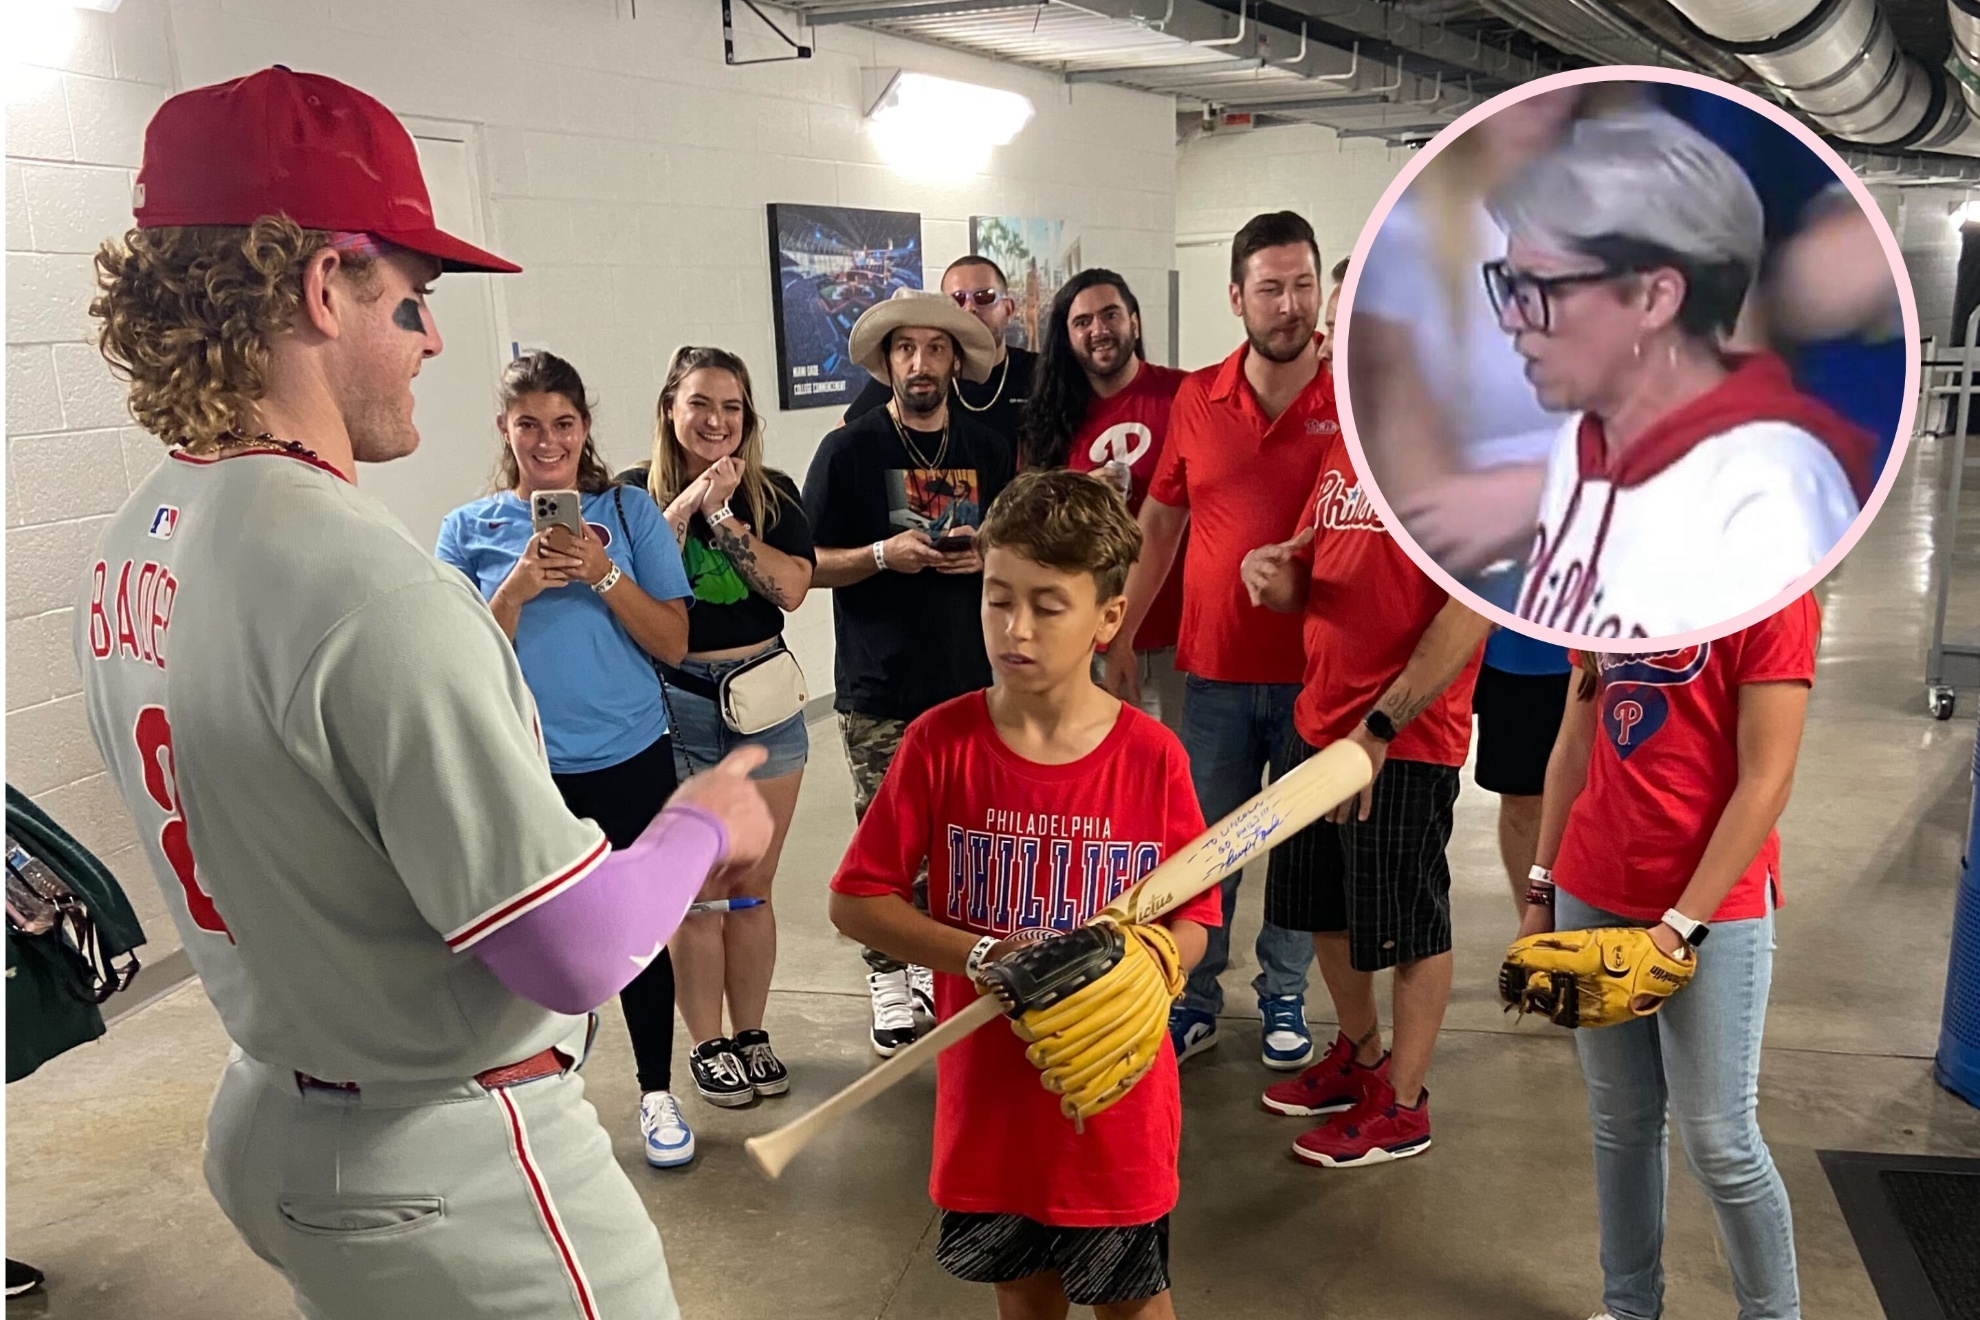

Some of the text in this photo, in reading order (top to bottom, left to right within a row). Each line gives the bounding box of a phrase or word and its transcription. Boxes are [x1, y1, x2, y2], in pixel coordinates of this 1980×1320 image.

[1088, 421, 1152, 468] P
[1613, 700, 1643, 745] P
[986, 808, 1112, 839] PHILADELPHIA
